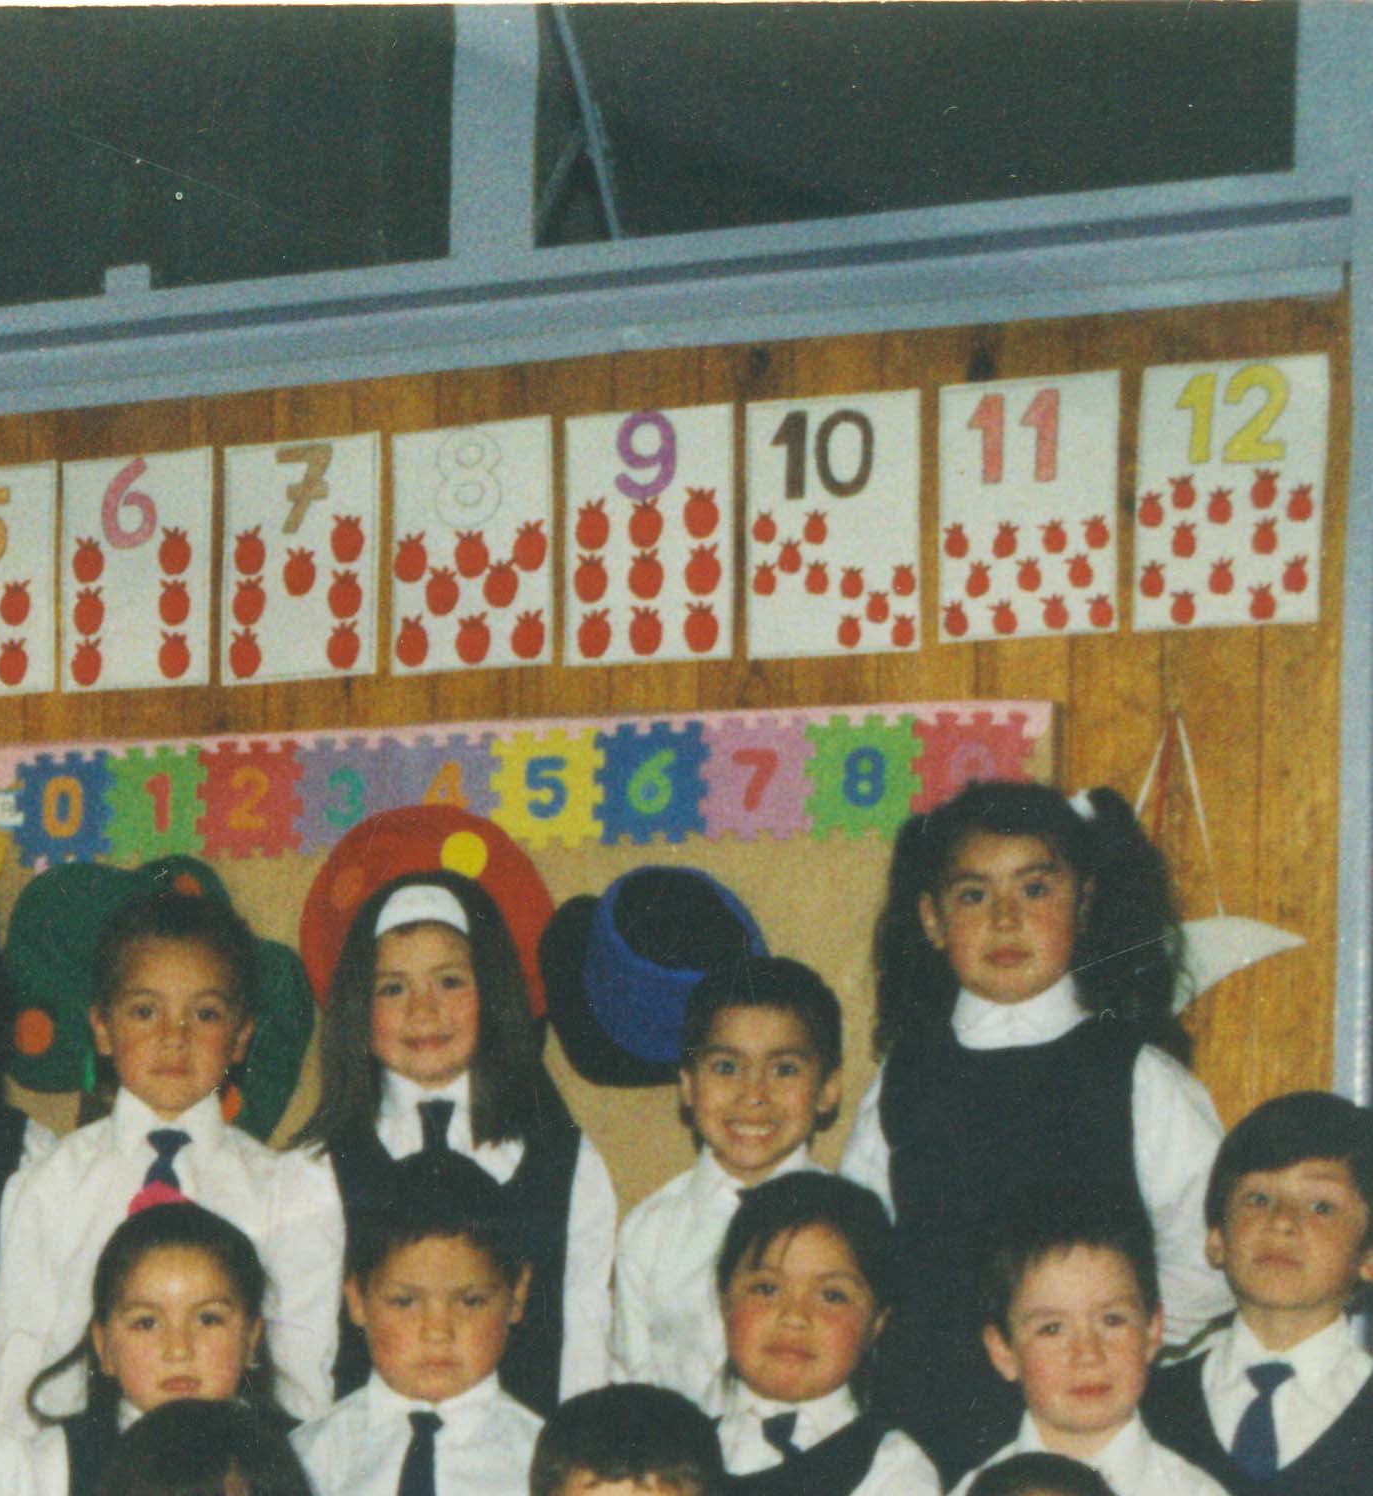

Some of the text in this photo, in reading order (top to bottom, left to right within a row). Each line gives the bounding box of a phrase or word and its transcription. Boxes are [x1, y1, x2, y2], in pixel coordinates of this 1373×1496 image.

[101, 457, 158, 550] 6
[275, 442, 333, 535] 7
[435, 427, 504, 528] 8
[615, 409, 677, 501] 9
[770, 409, 876, 500] 10
[966, 388, 1061, 484] 11
[1175, 365, 1291, 465] 12
[42, 775, 84, 839] 0
[144, 772, 171, 833] 1
[228, 765, 269, 831] 2
[325, 767, 366, 827] 3
[422, 761, 469, 807] 4
[525, 755, 568, 820] 5
[626, 750, 674, 815] 6
[733, 749, 779, 815] 7
[842, 746, 887, 809] 8
